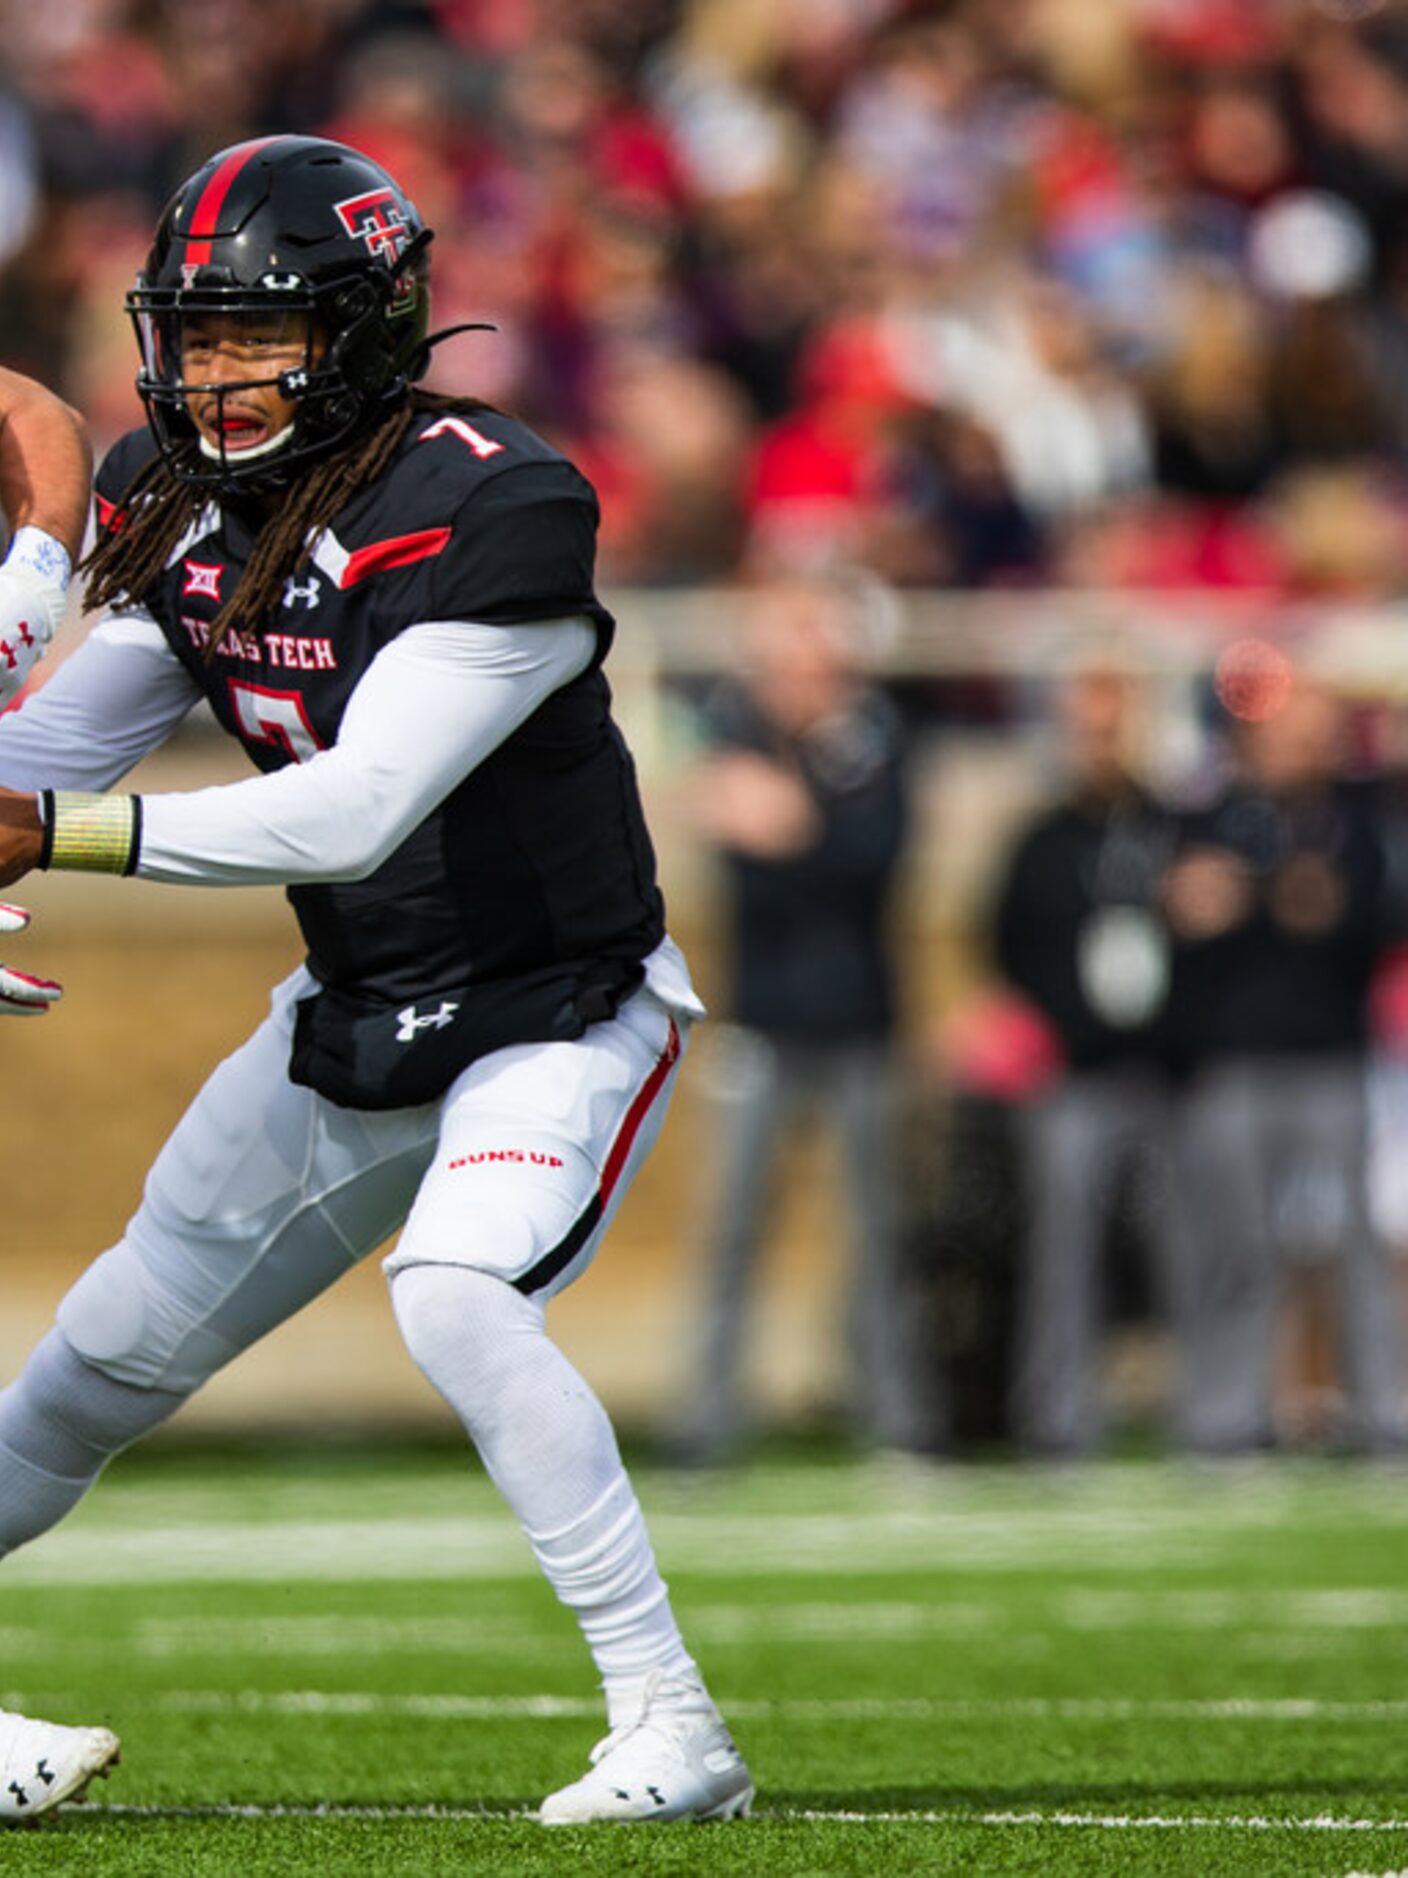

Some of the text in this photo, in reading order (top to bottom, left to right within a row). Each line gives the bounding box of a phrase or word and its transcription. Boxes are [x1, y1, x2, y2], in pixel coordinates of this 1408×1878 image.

[417, 416, 505, 461] 7
[263, 632, 338, 670] TECH
[227, 676, 326, 765] 7
